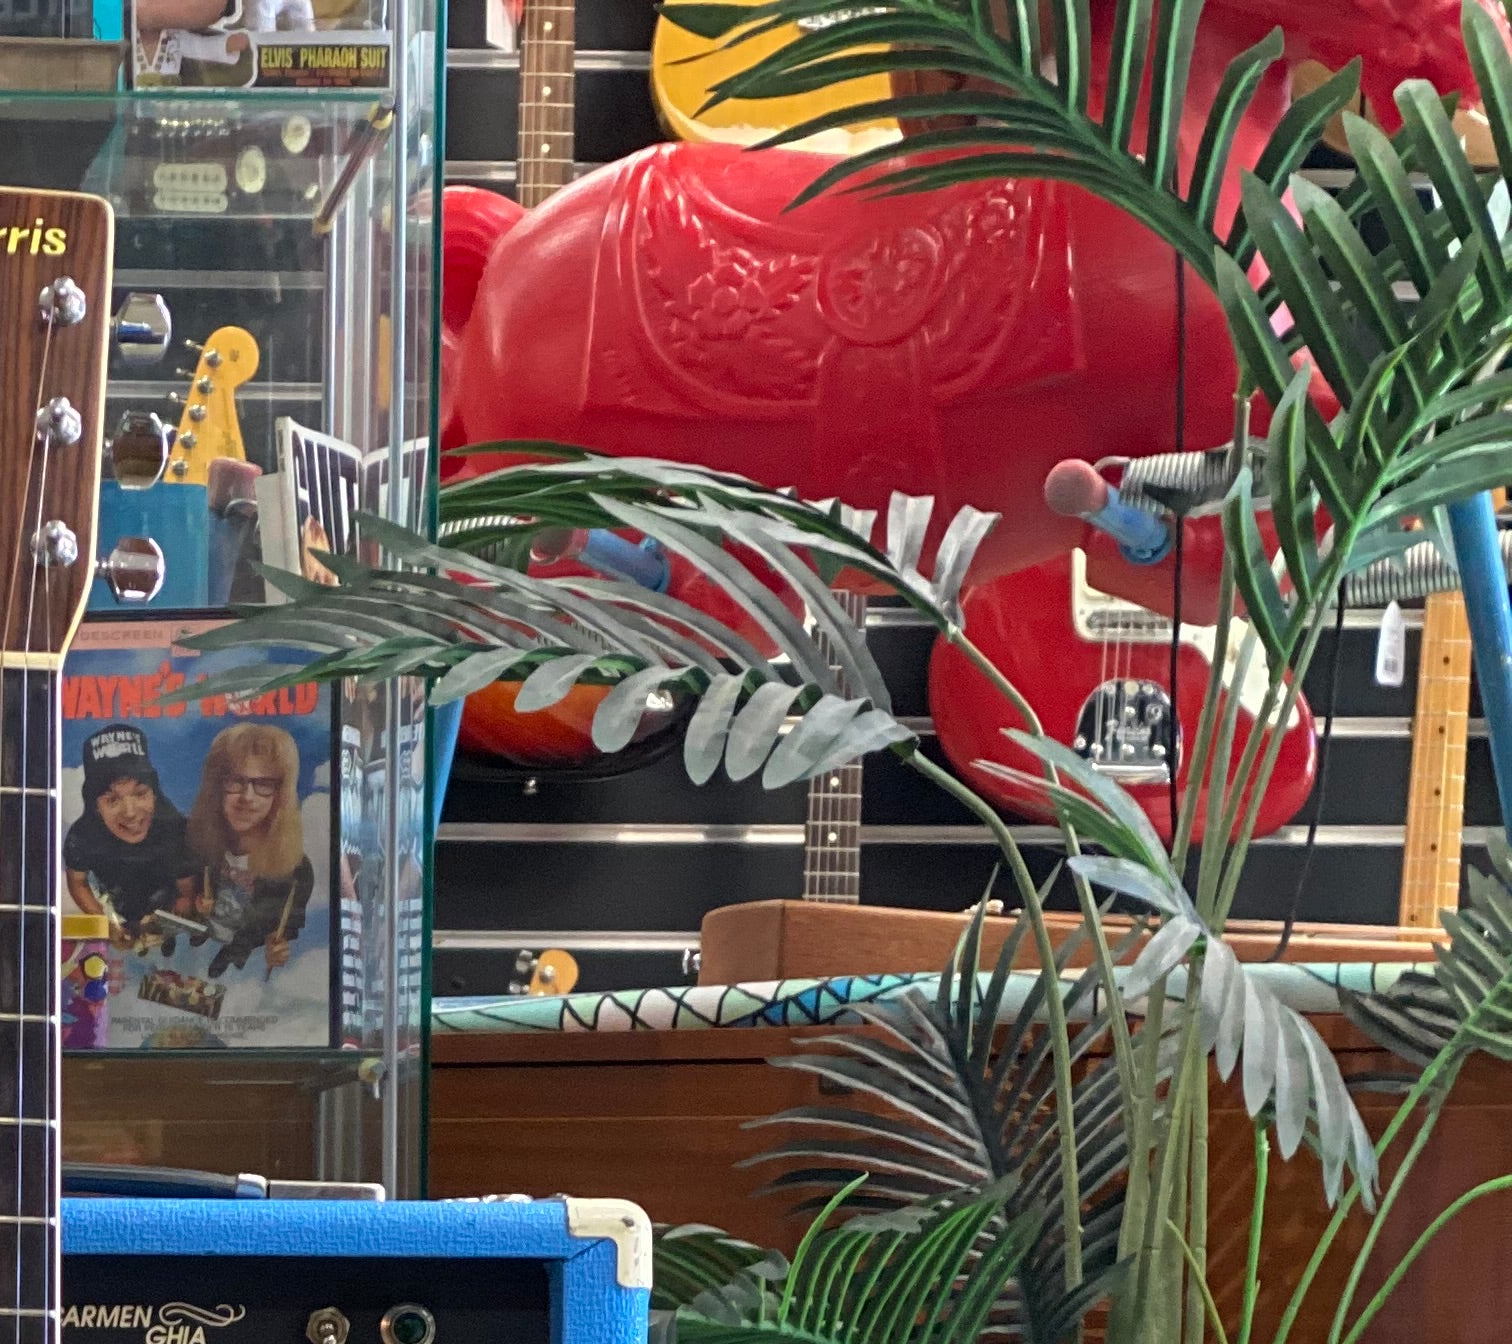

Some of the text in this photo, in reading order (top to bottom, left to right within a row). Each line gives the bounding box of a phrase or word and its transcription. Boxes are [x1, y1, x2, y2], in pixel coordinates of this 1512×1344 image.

[261, 47, 388, 68] ELVIS PHARAOH SUIT
[79, 629, 163, 641] DESCREEN
